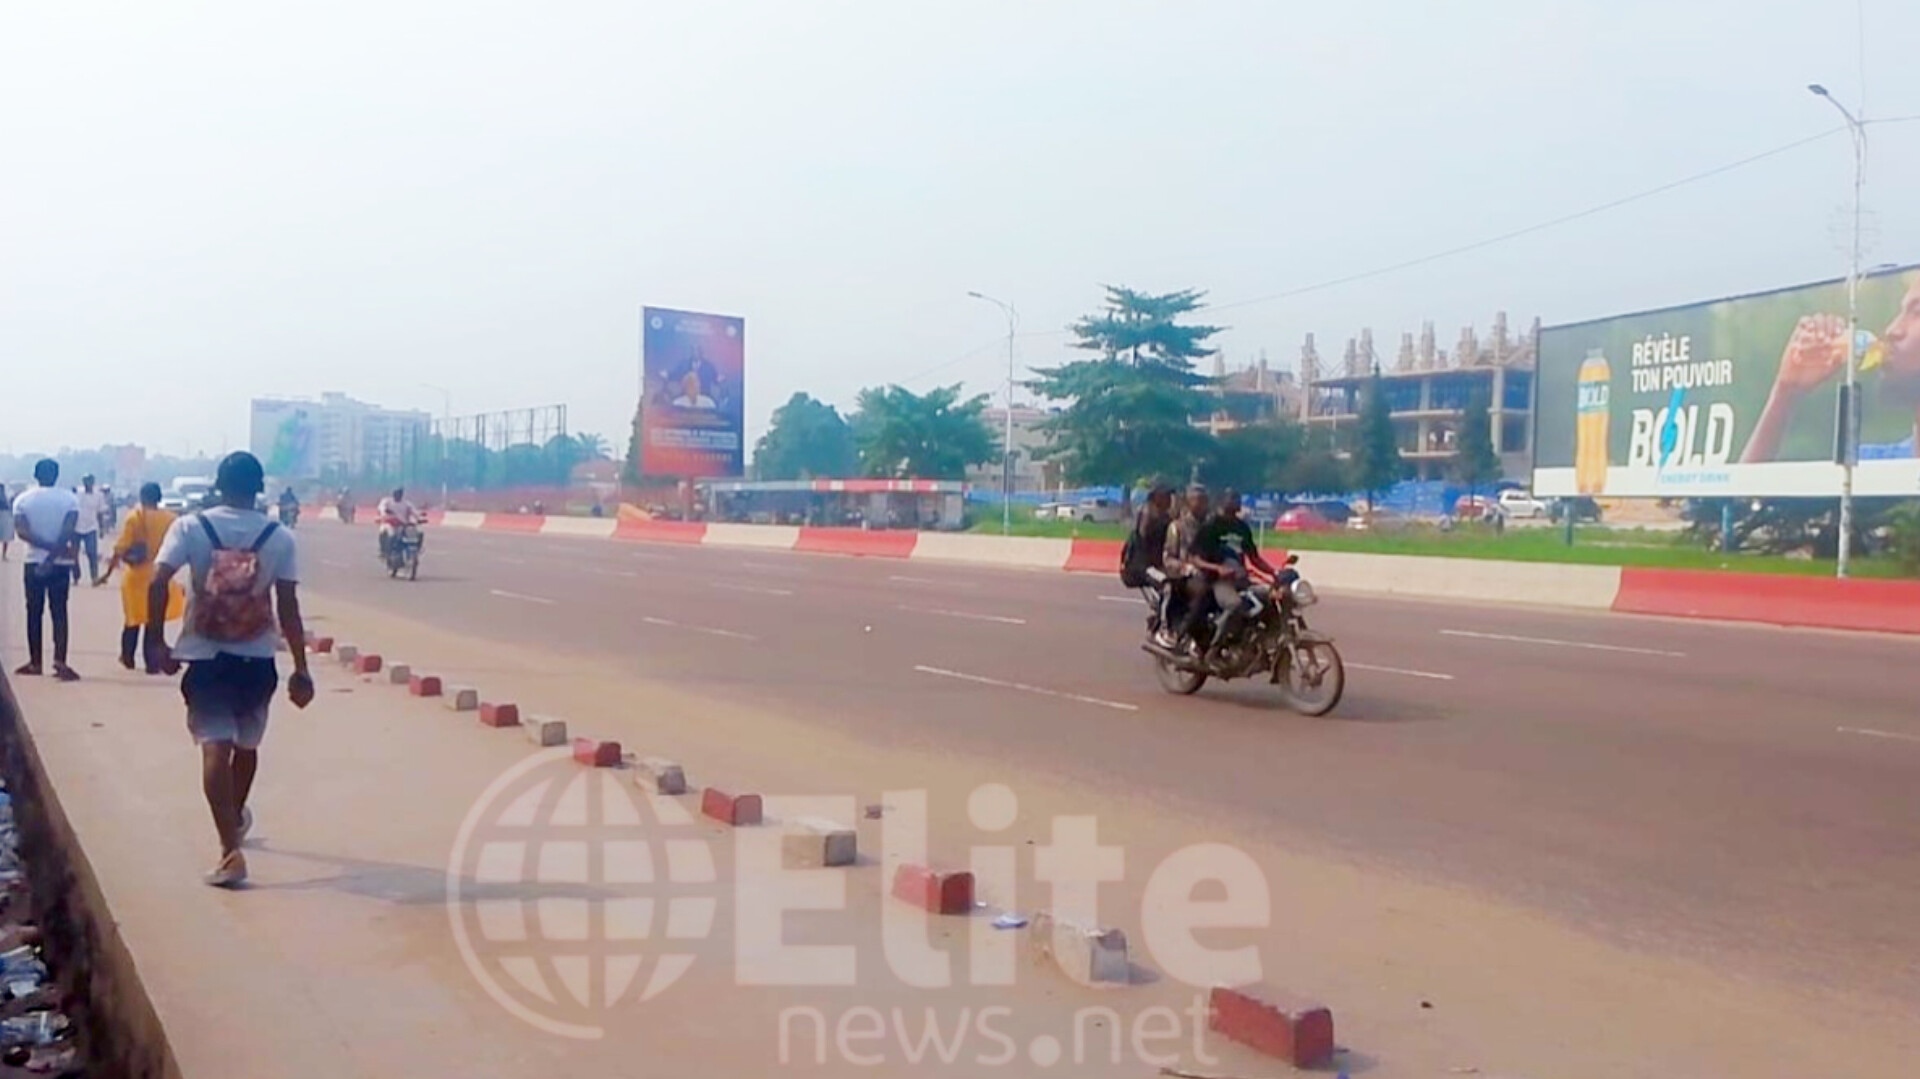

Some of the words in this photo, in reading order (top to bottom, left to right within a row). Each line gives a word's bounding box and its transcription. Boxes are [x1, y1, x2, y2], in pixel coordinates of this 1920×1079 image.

[1632, 332, 1690, 366] RÉVÈLE
[1632, 368, 1660, 393] TON
[1663, 360, 1732, 390] POUVOIR
[1578, 385, 1609, 407] BOLD
[1629, 403, 1734, 467] BOLD
